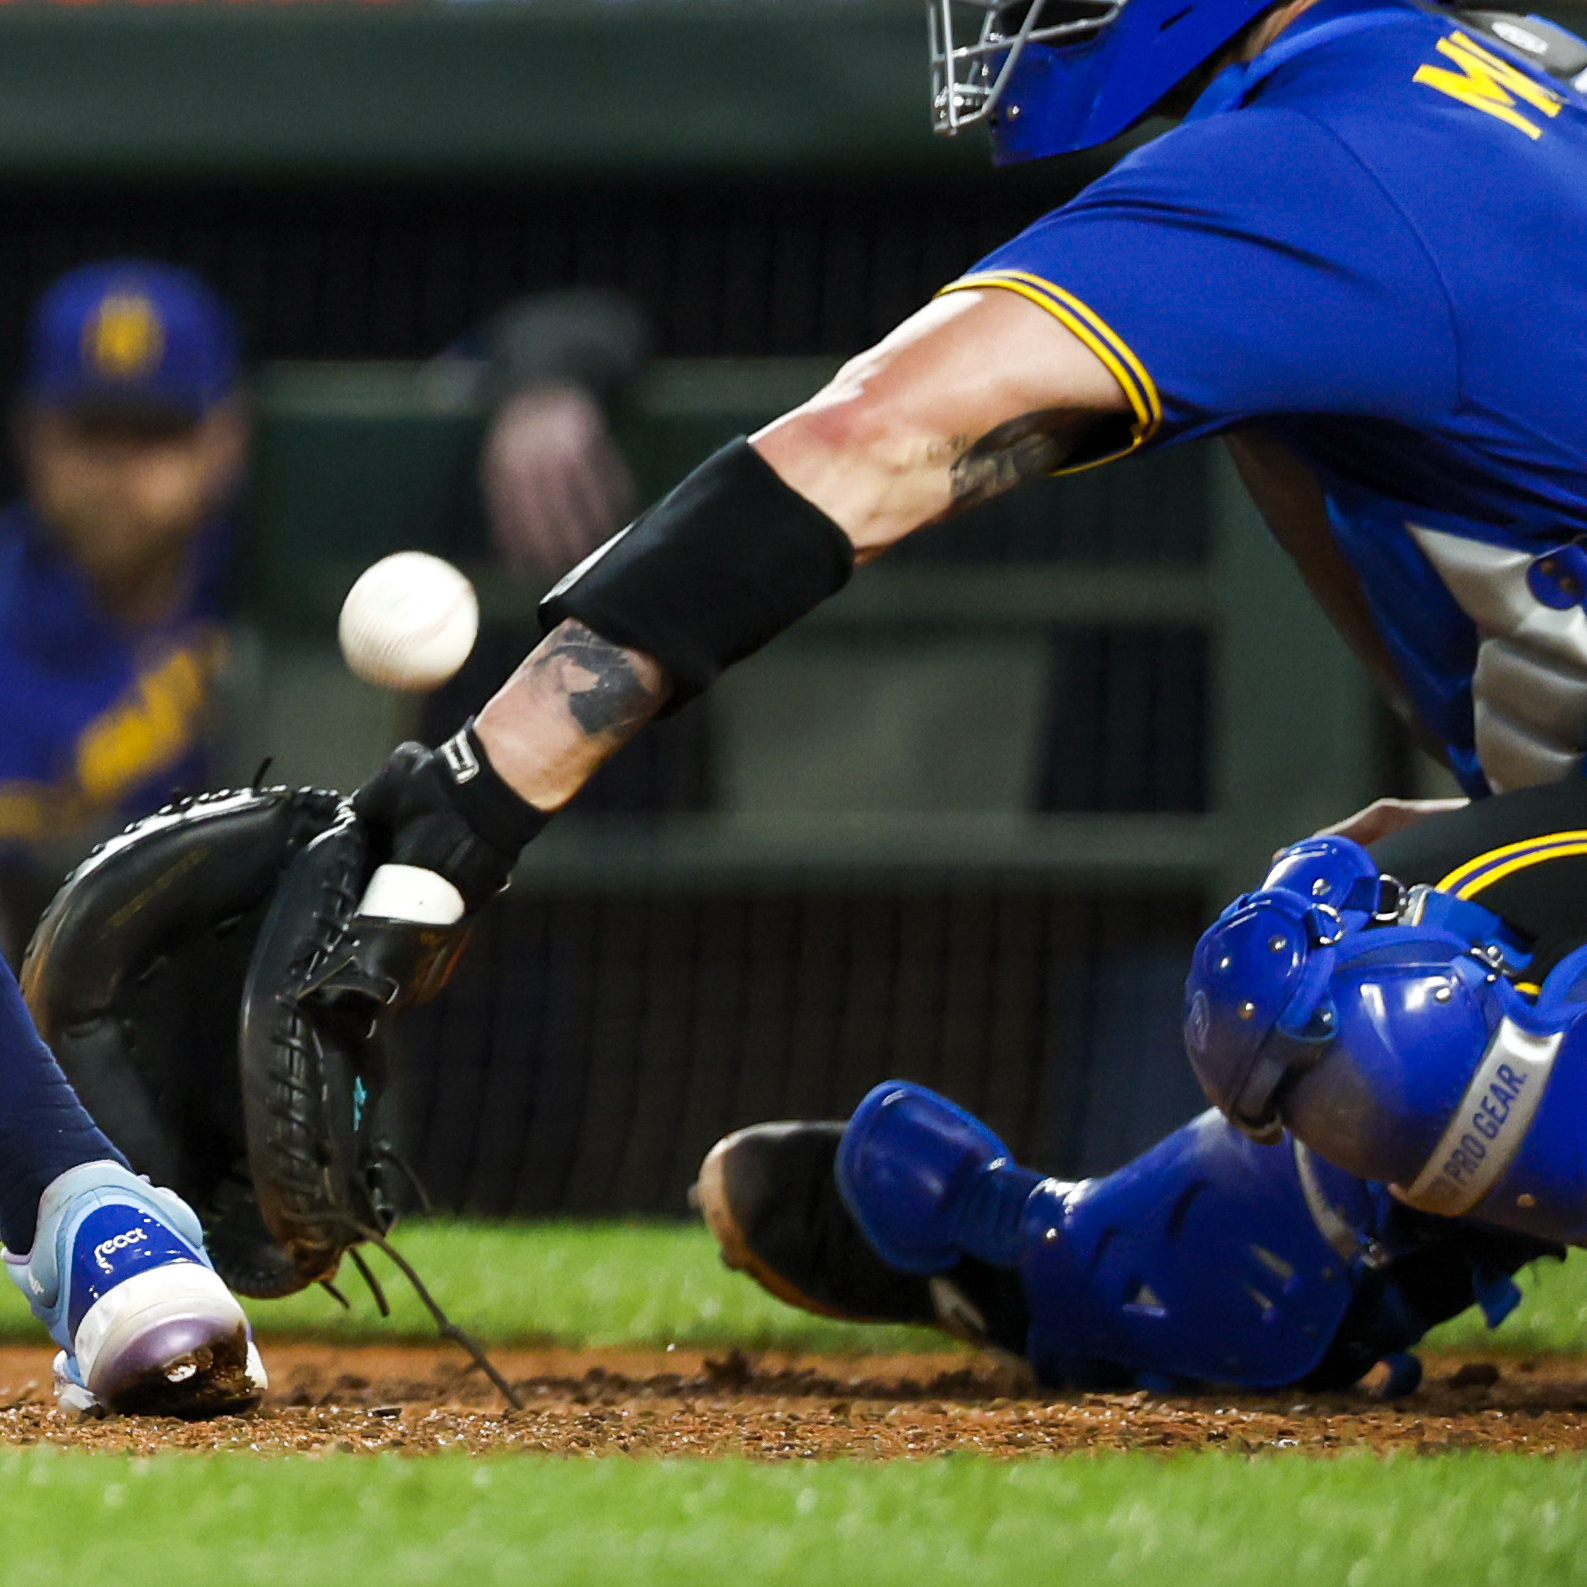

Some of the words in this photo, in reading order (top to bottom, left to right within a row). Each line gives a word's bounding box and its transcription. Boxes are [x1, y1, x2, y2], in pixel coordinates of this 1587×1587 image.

[1412, 30, 1568, 141] M
[1443, 1133, 1487, 1183] PRO
[1472, 1063, 1524, 1140] GEAR
